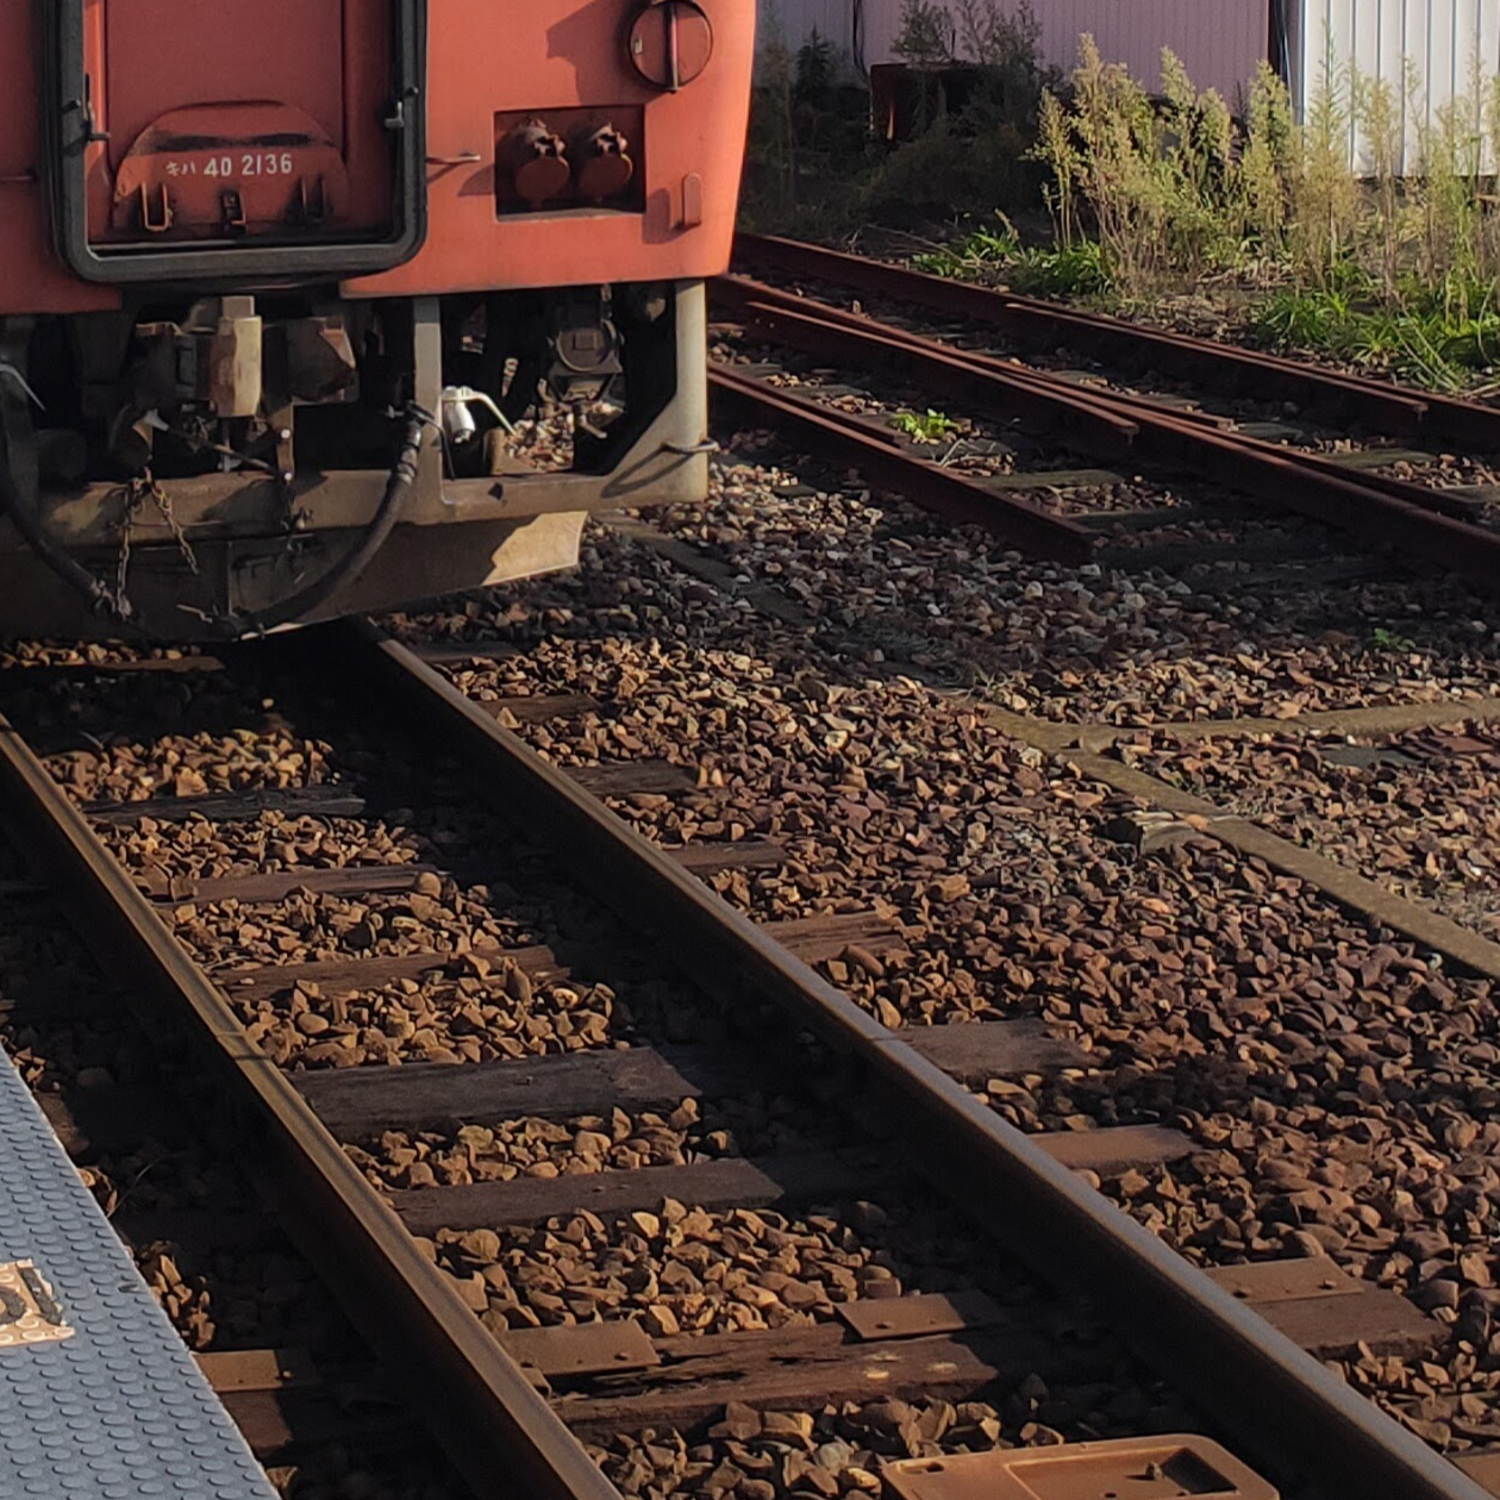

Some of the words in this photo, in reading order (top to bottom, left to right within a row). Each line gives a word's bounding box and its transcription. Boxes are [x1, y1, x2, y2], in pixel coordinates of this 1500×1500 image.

[166, 161, 197, 177] キハ
[203, 157, 232, 177] 40
[241, 153, 293, 176] 2136
